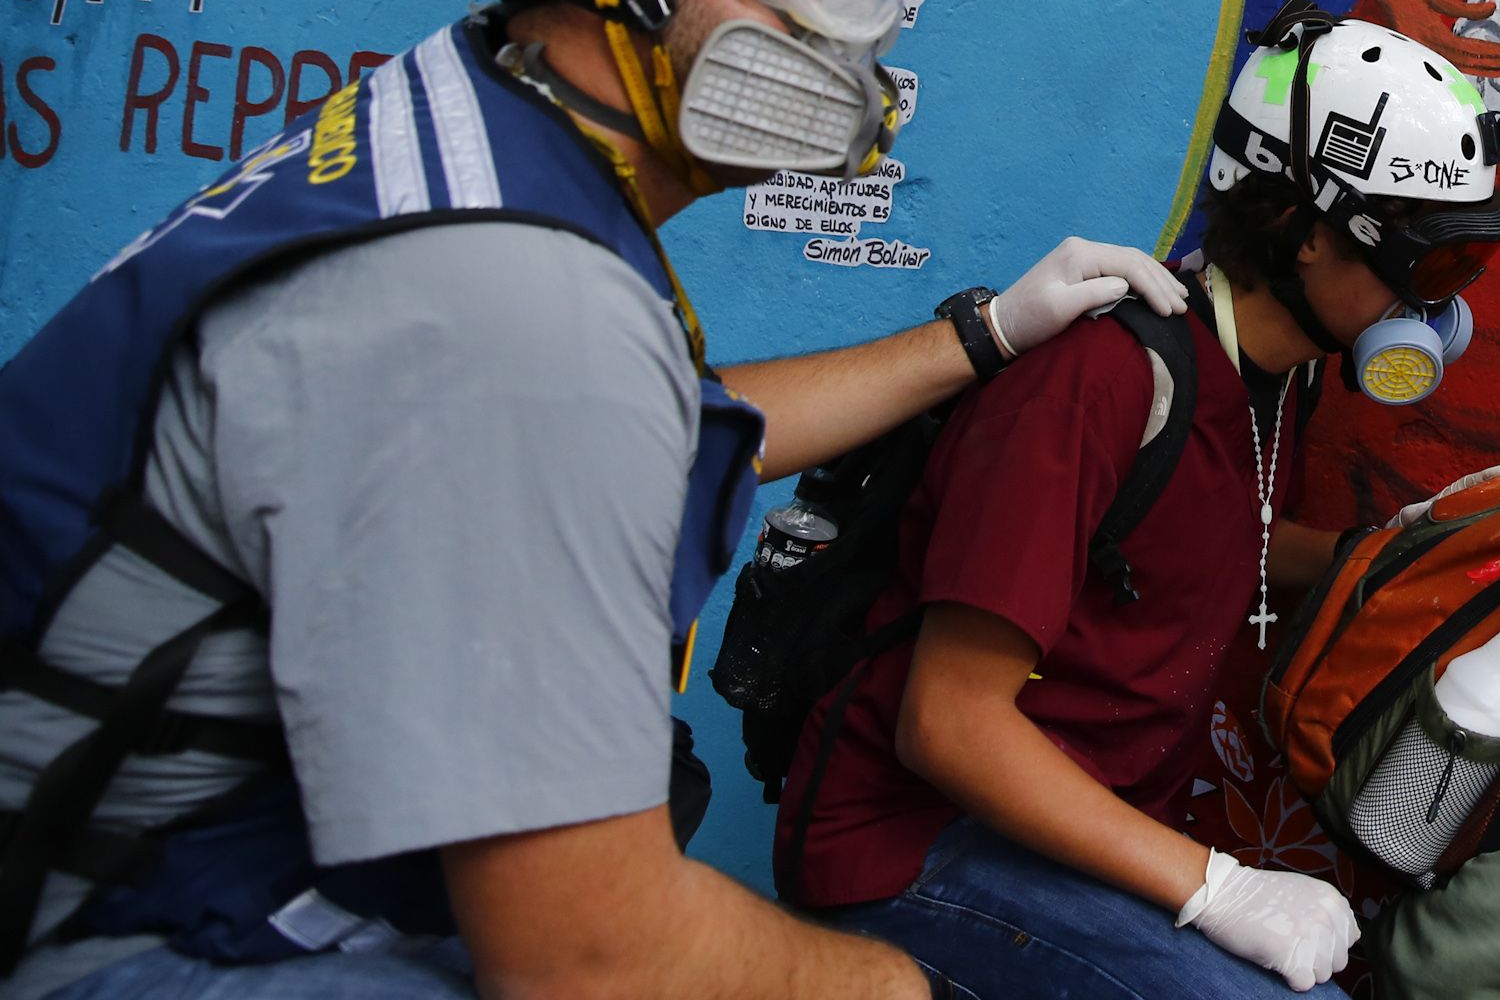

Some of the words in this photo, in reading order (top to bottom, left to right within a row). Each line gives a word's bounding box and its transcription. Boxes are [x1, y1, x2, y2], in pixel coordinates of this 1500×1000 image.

[749, 193, 757, 210] Y
[795, 218, 813, 230] DE
[806, 237, 861, 262] Simón
